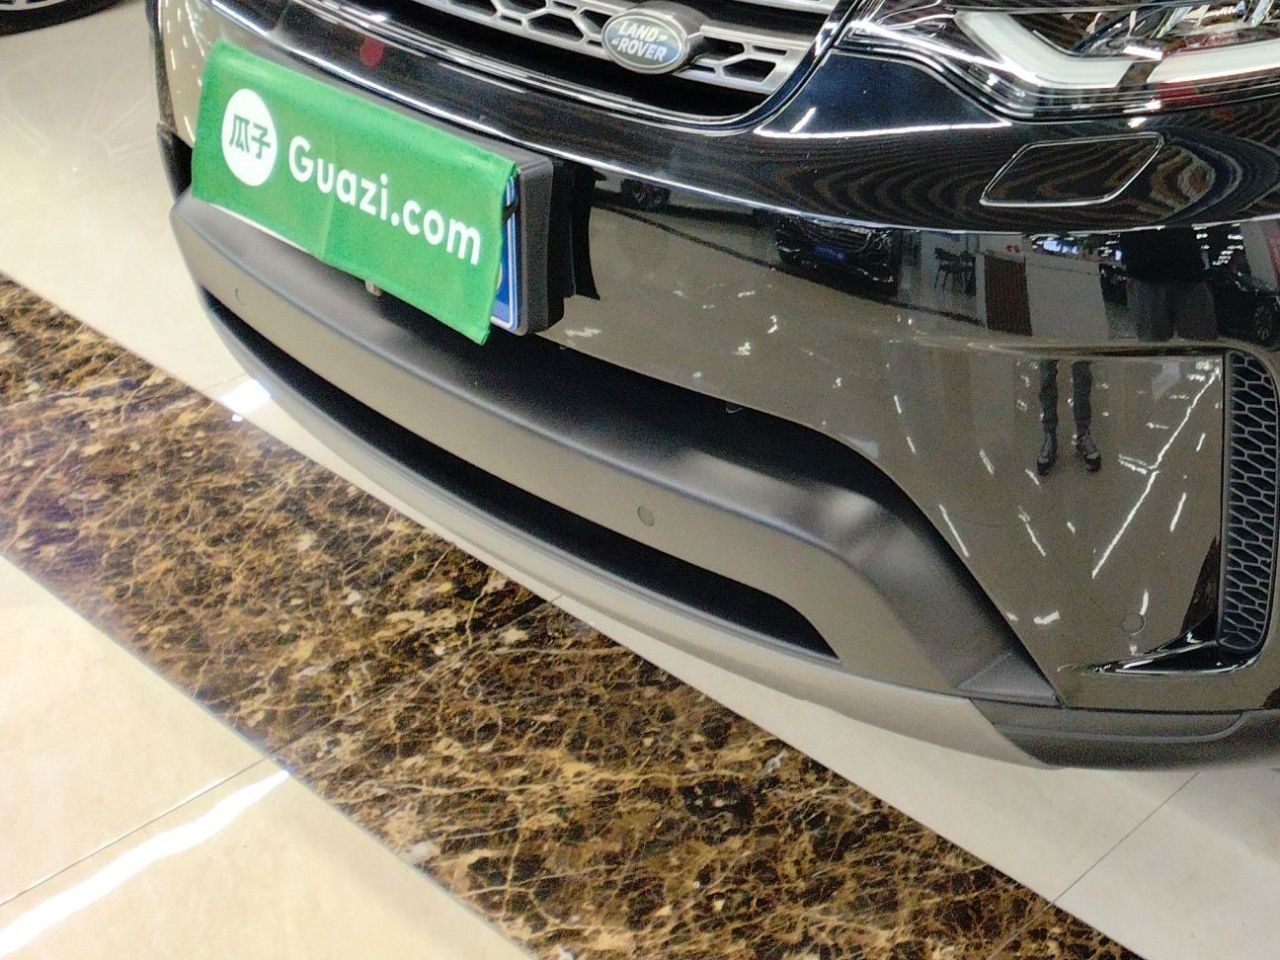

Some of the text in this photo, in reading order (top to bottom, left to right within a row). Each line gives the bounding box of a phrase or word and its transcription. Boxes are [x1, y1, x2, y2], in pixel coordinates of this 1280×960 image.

[618, 21, 659, 42] LAND
[617, 38, 667, 62] ROVER
[229, 113, 271, 160] 瓜子
[288, 135, 481, 266] Guazi.com
